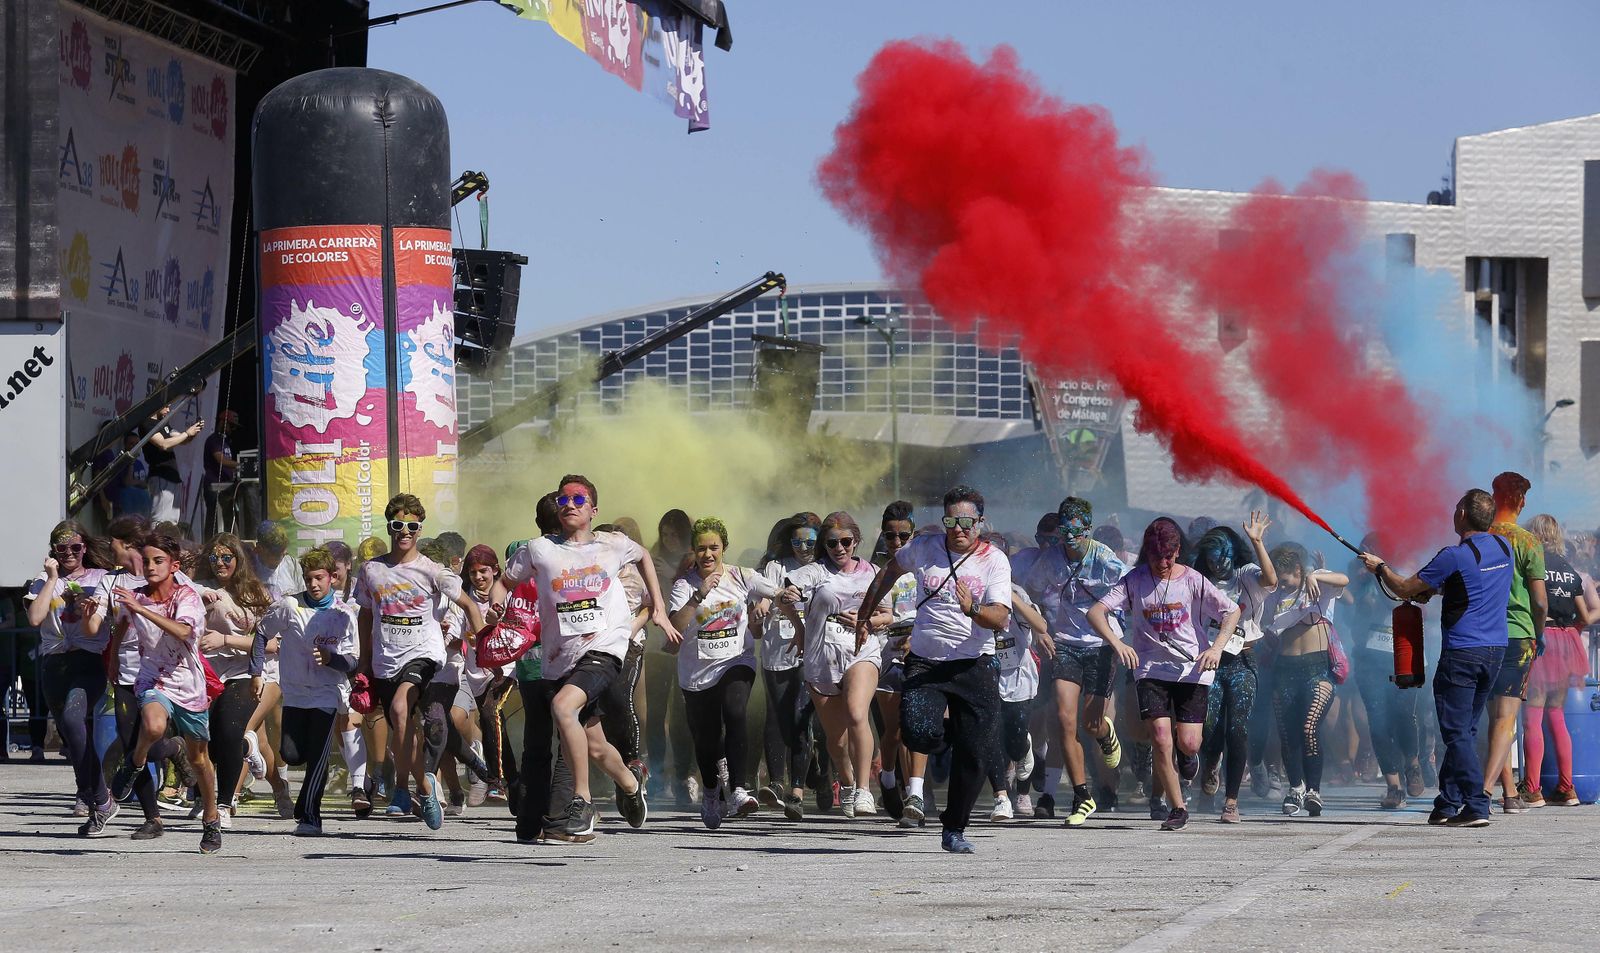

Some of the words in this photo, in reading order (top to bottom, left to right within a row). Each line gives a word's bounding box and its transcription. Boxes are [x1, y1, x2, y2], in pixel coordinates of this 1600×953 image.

[146, 67, 165, 103] HOLI
[192, 84, 209, 120] HOLI
[99, 154, 119, 191] HOLI
[263, 243, 272, 253] LA
[272, 239, 318, 252] PRIMERA
[319, 237, 377, 249] CARRERA
[400, 240, 413, 250] LA
[414, 240, 446, 252] PRIMERA
[281, 254, 294, 265] DE
[295, 252, 349, 264] COLORES
[425, 254, 436, 265] DE
[93, 365, 113, 400] HOLI
[1063, 393, 1113, 407] Congresos
[1057, 409, 1070, 419] de
[432, 439, 458, 526] OLI
[563, 578, 583, 589] HOLI
[1544, 570, 1575, 584] STAFF
[509, 597, 532, 612] HOLI
[570, 612, 595, 624] 0653
[391, 627, 412, 636] 0799
[709, 640, 730, 650] 0630
